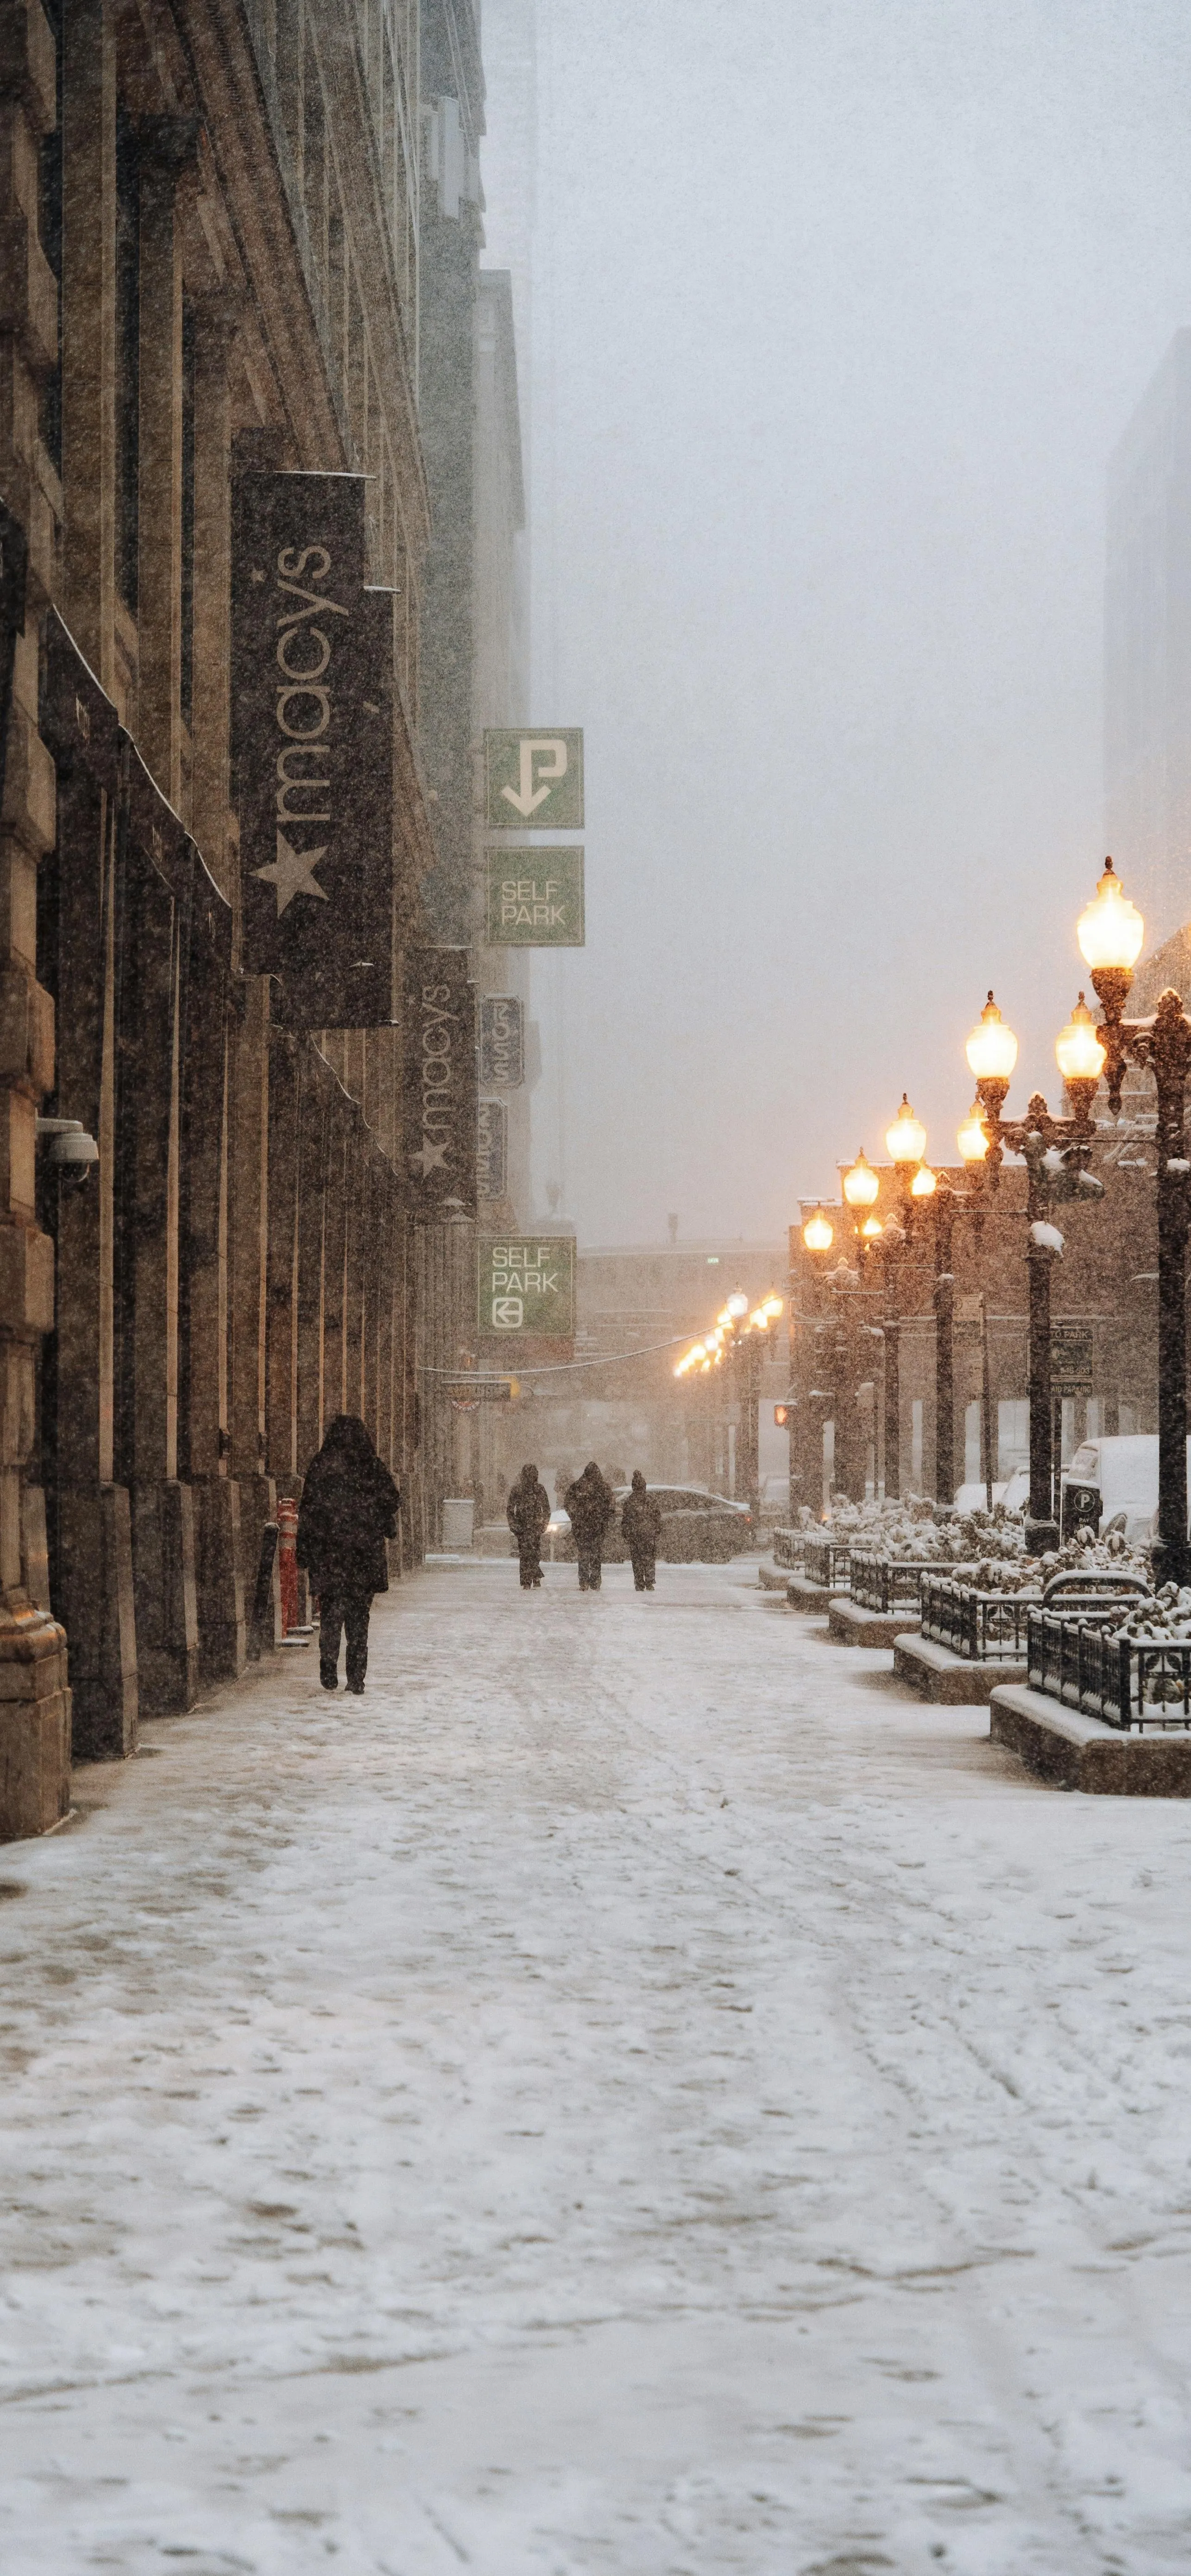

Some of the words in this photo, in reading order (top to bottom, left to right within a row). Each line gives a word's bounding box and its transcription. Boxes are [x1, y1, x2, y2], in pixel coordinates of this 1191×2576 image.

[502, 881, 558, 902] SELF
[502, 905, 566, 925] PARK
[492, 1002, 510, 1084] ROSS
[492, 1247, 551, 1267] SELF
[492, 1272, 559, 1293] PARK
[1080, 1494, 1090, 1508] P
